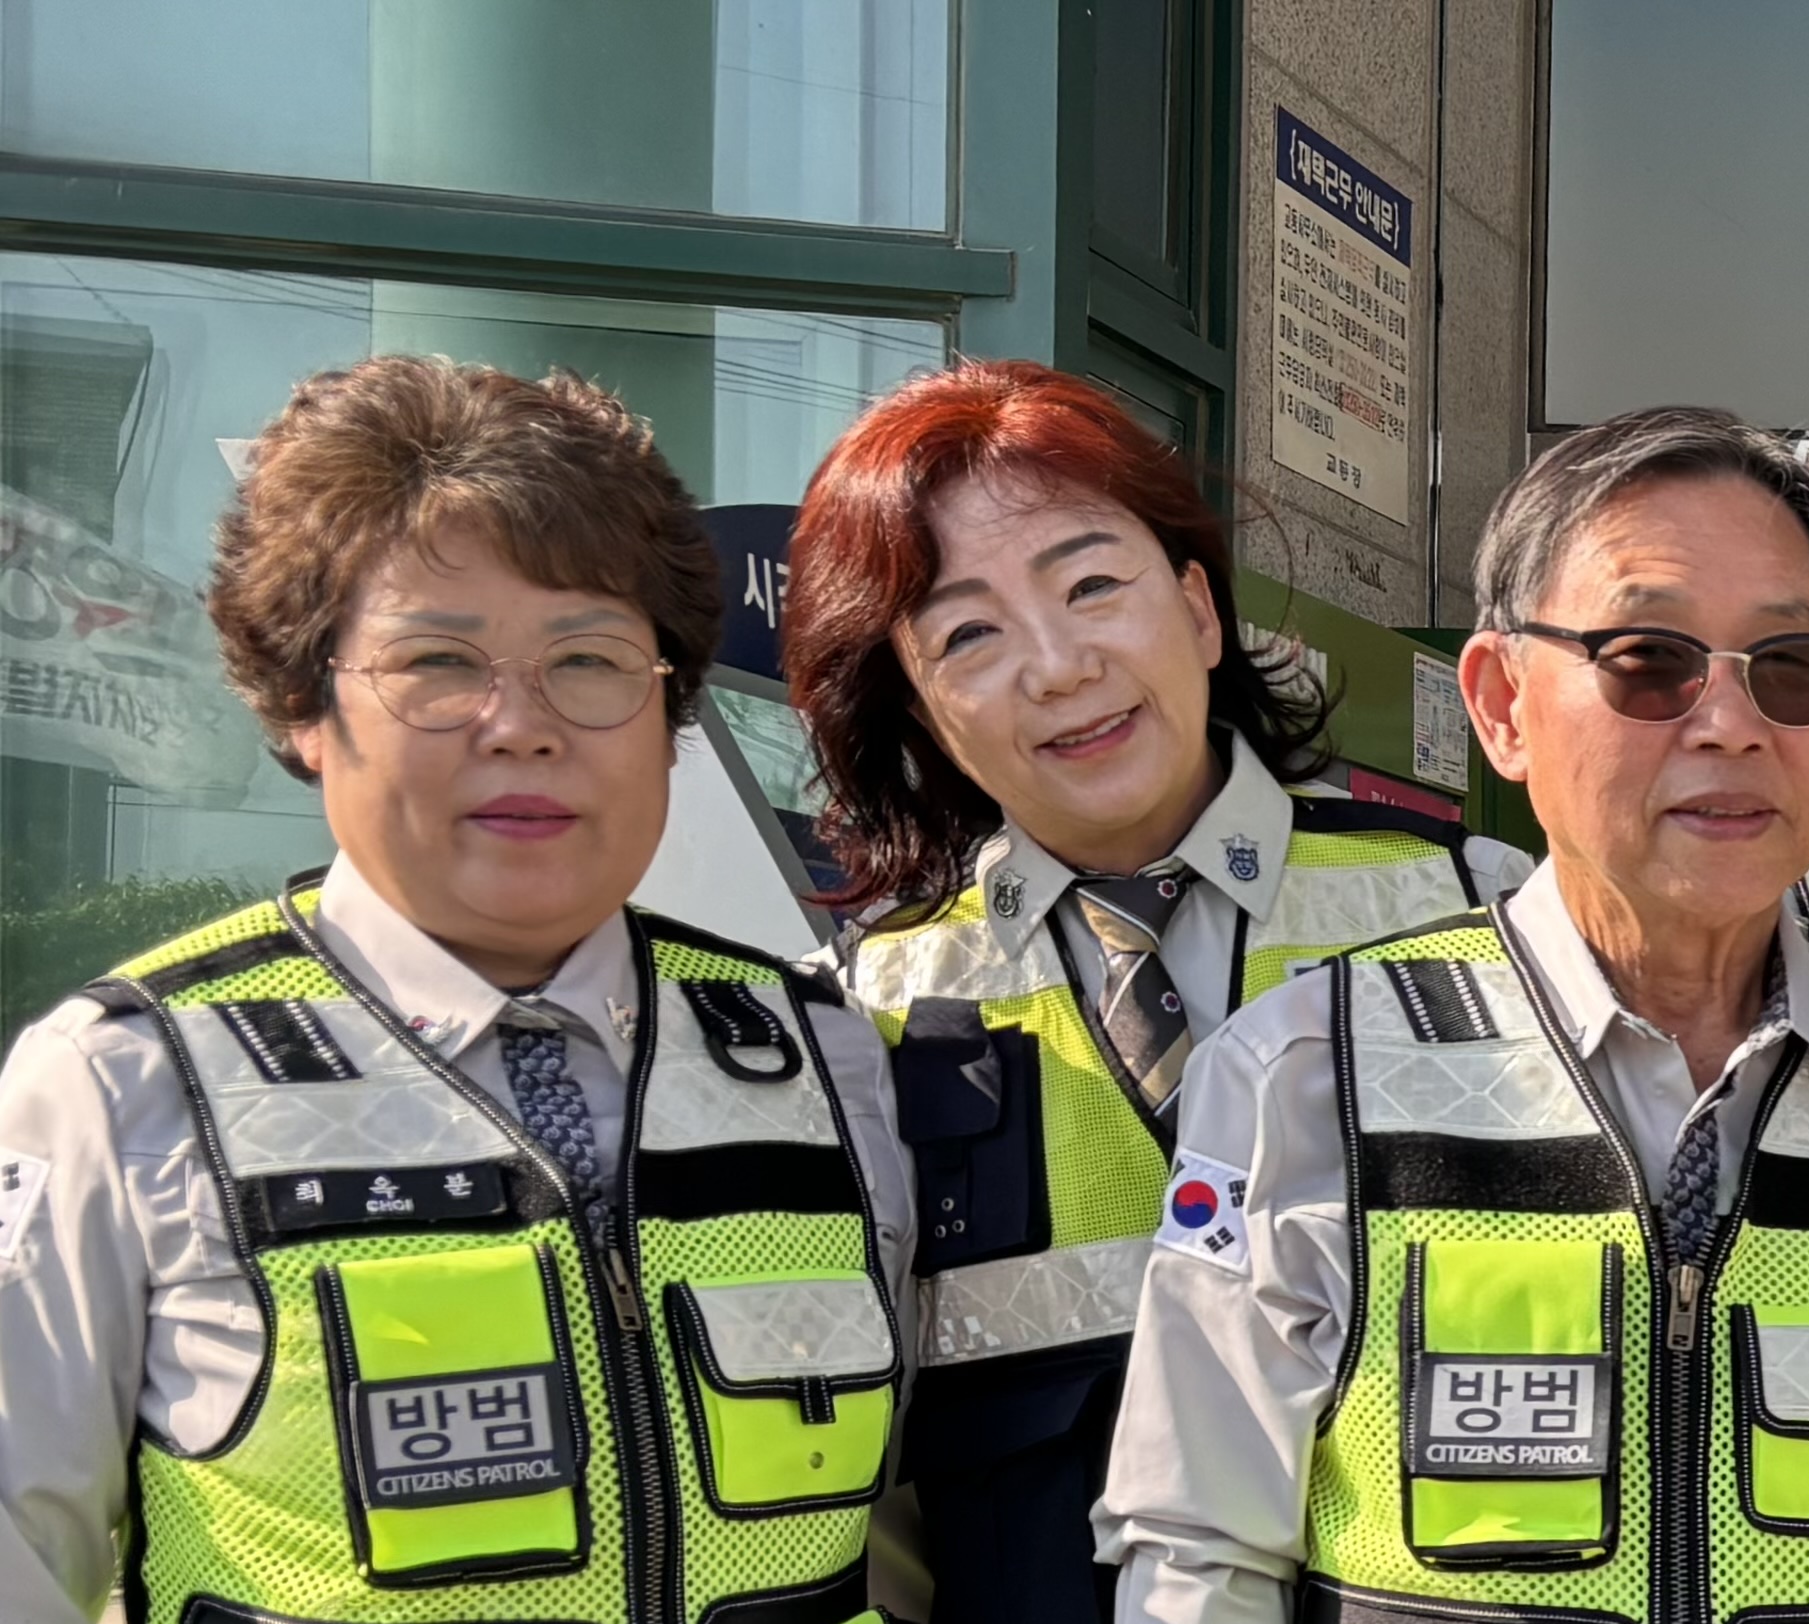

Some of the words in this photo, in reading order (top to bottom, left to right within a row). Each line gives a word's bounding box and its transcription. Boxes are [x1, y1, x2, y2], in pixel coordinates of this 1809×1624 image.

[386, 1380, 536, 1461] 방범
[1448, 1369, 1580, 1434] 방범
[376, 1467, 476, 1496] CITIZENS
[476, 1457, 562, 1486] PATROL
[1425, 1443, 1516, 1465] CITIZENS
[1517, 1443, 1594, 1466] PATROL
